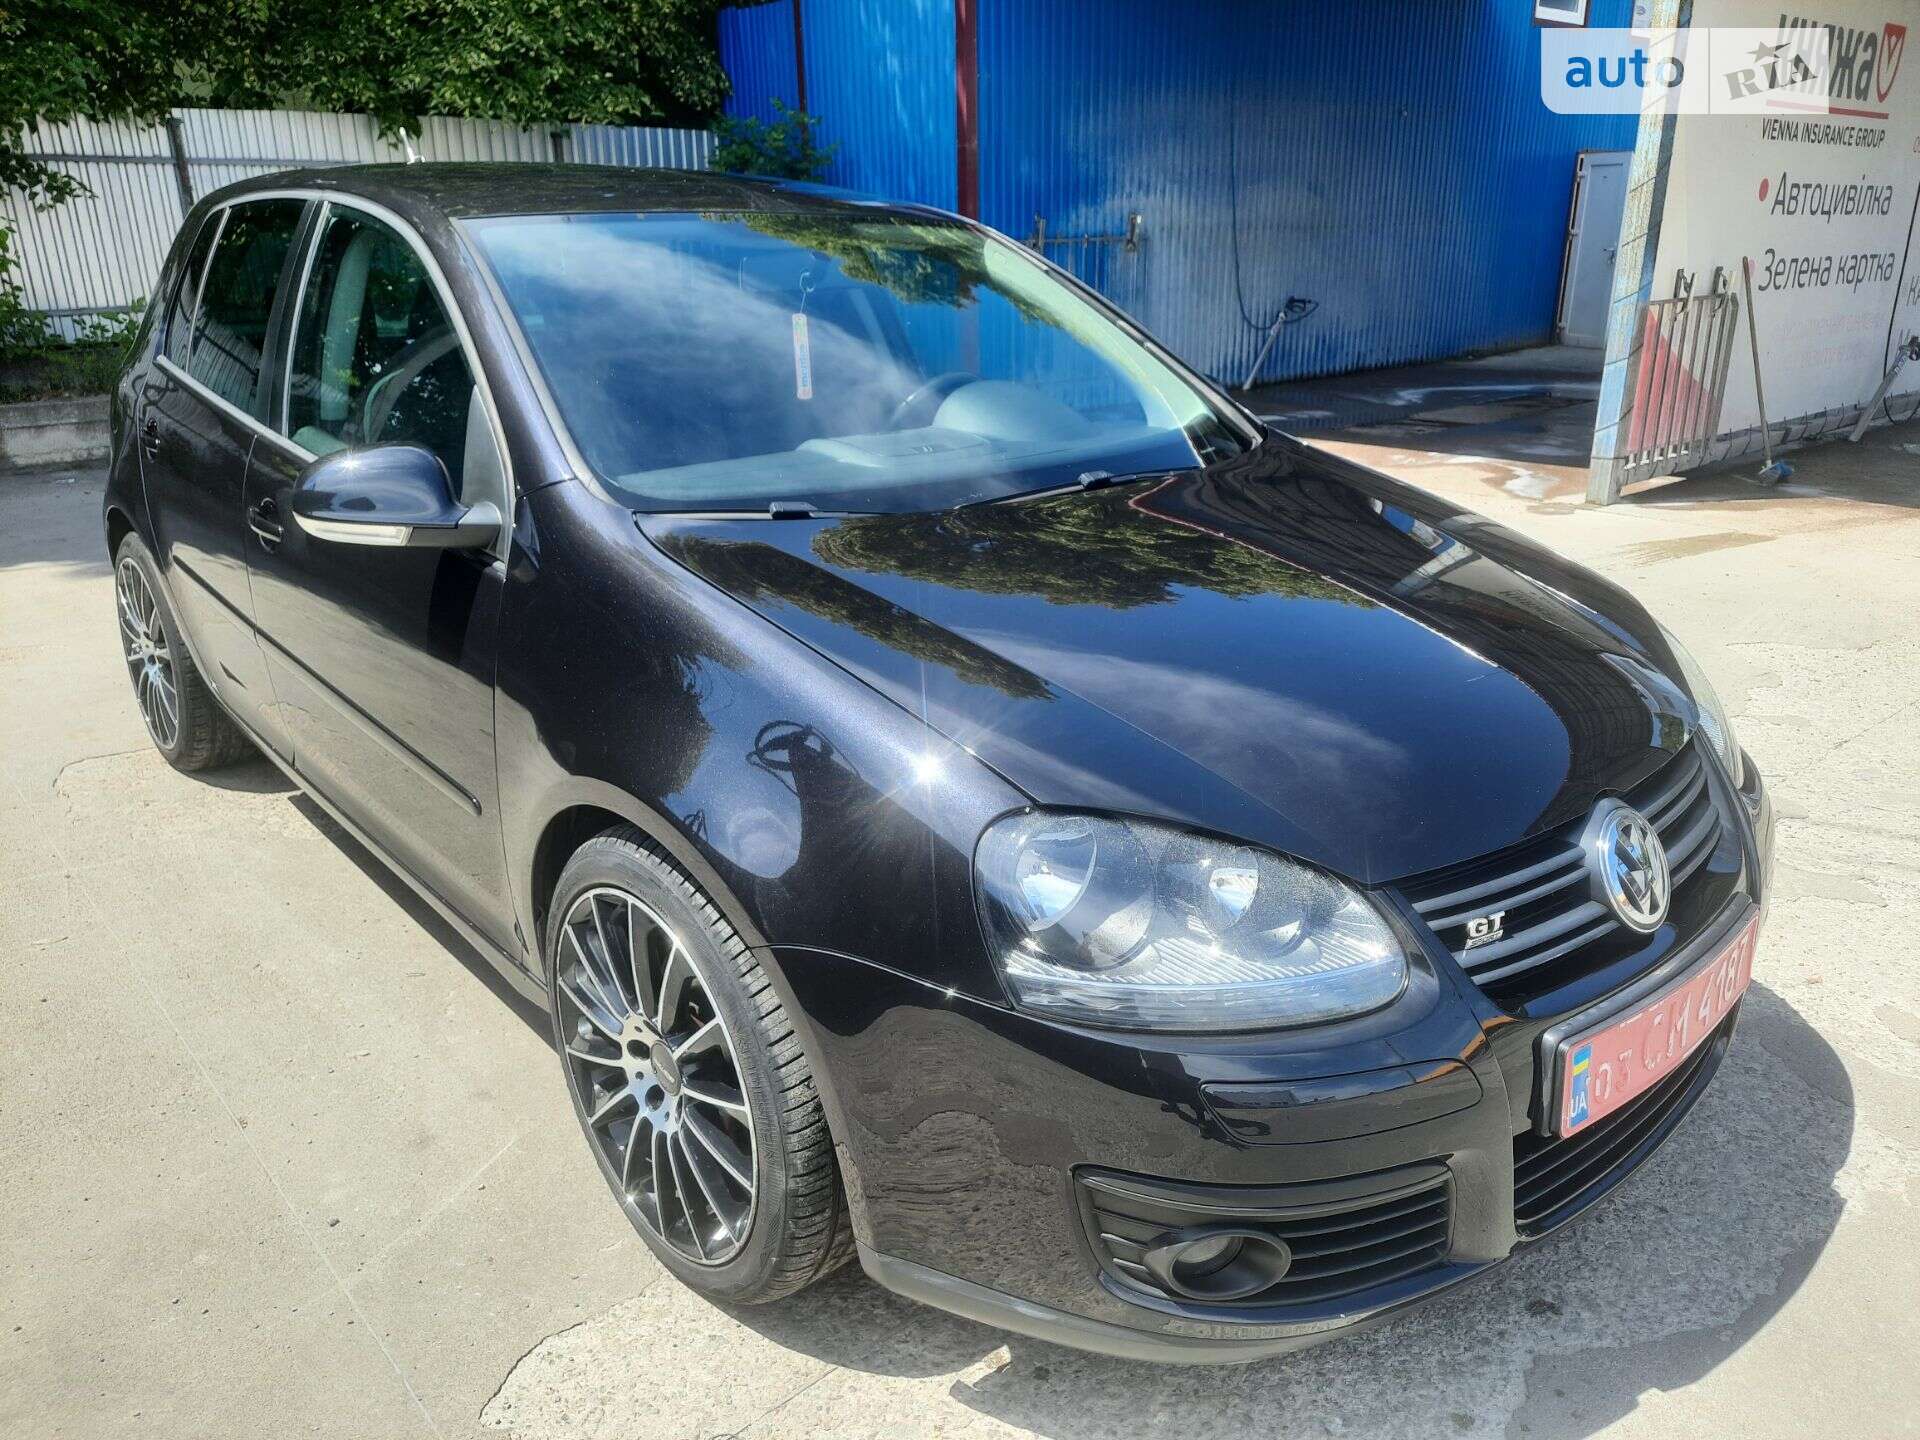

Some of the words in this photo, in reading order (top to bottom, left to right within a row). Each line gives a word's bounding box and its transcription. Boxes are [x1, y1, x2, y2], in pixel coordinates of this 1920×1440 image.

[1762, 118, 1799, 142] VIENNA
[1800, 121, 1855, 146] INSURANCE
[1855, 128, 1886, 148] GROUP
[1771, 171, 1893, 224] Автоцивілка
[1758, 248, 1832, 291] Зелена
[1835, 252, 1895, 294] картка
[1466, 910, 1506, 938] GT
[1569, 1095, 1588, 1118] UA
